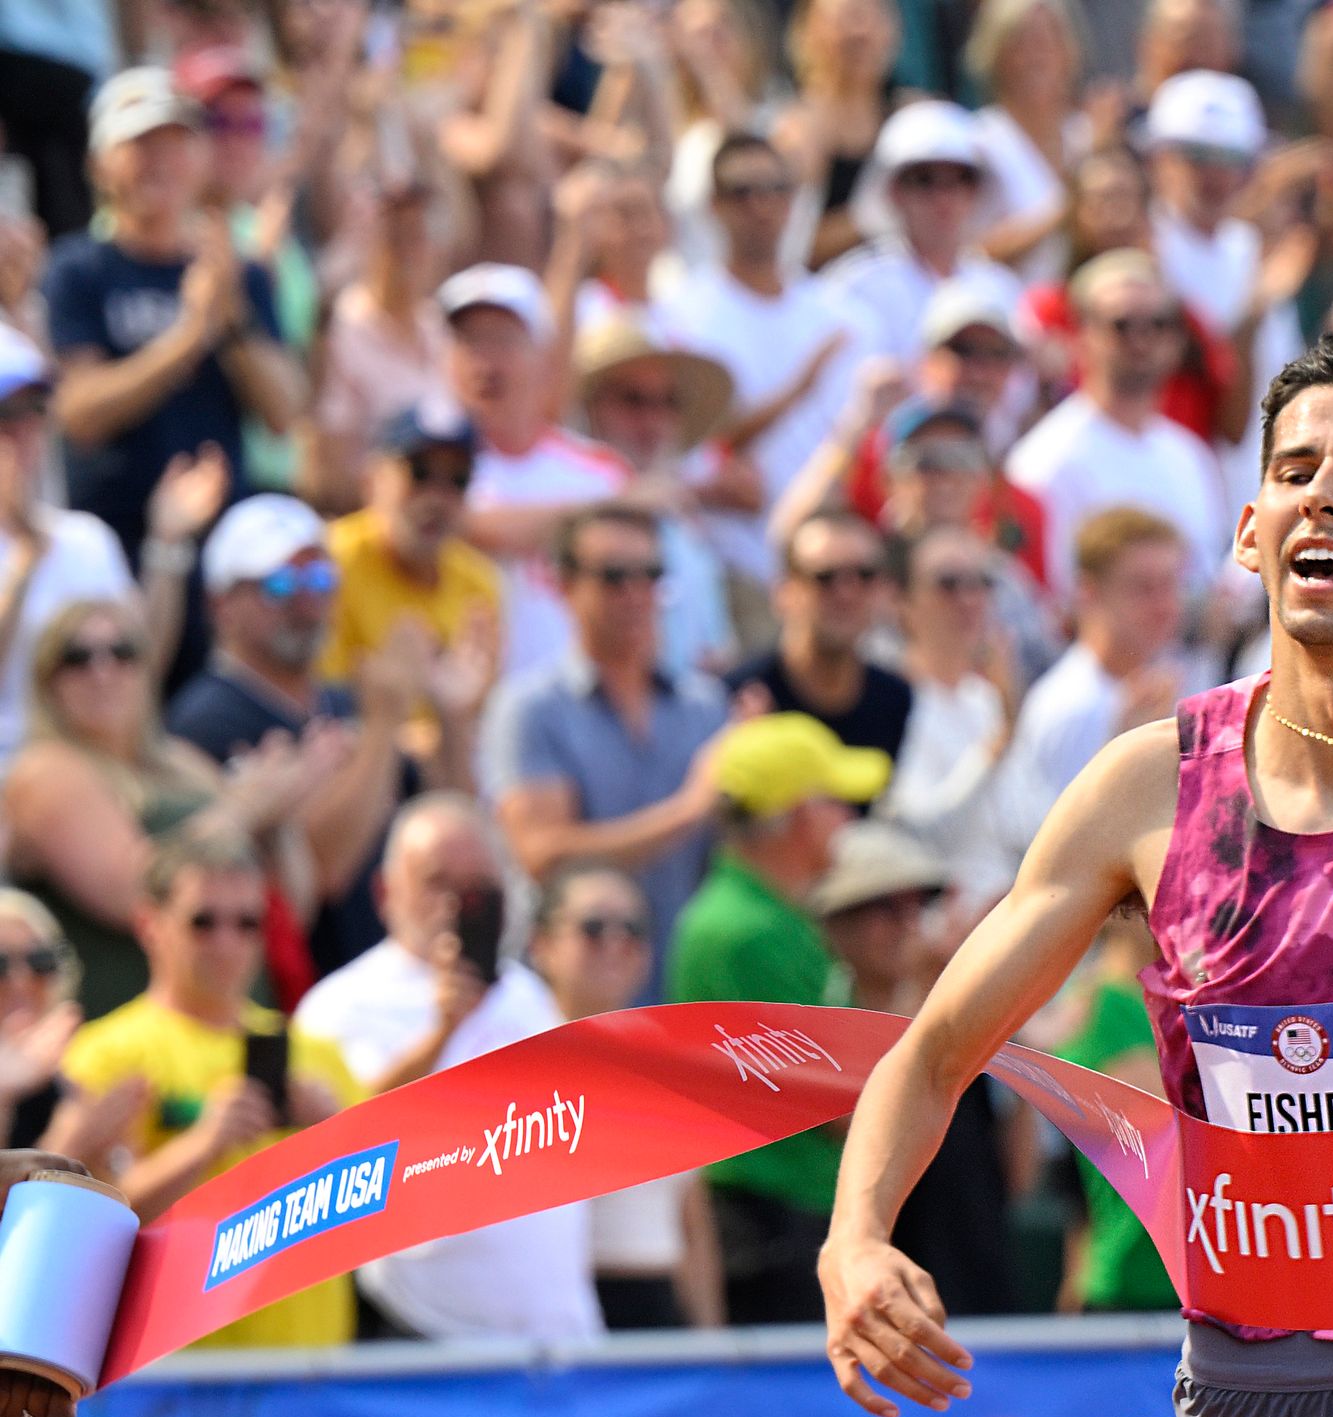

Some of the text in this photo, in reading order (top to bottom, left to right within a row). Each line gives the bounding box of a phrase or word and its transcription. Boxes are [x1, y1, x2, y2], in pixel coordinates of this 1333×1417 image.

[711, 1022, 842, 1092] xfinity
[1219, 1022, 1258, 1039] USATF
[211, 1089, 585, 1277] MAKING TEAM USA presented by xfinity
